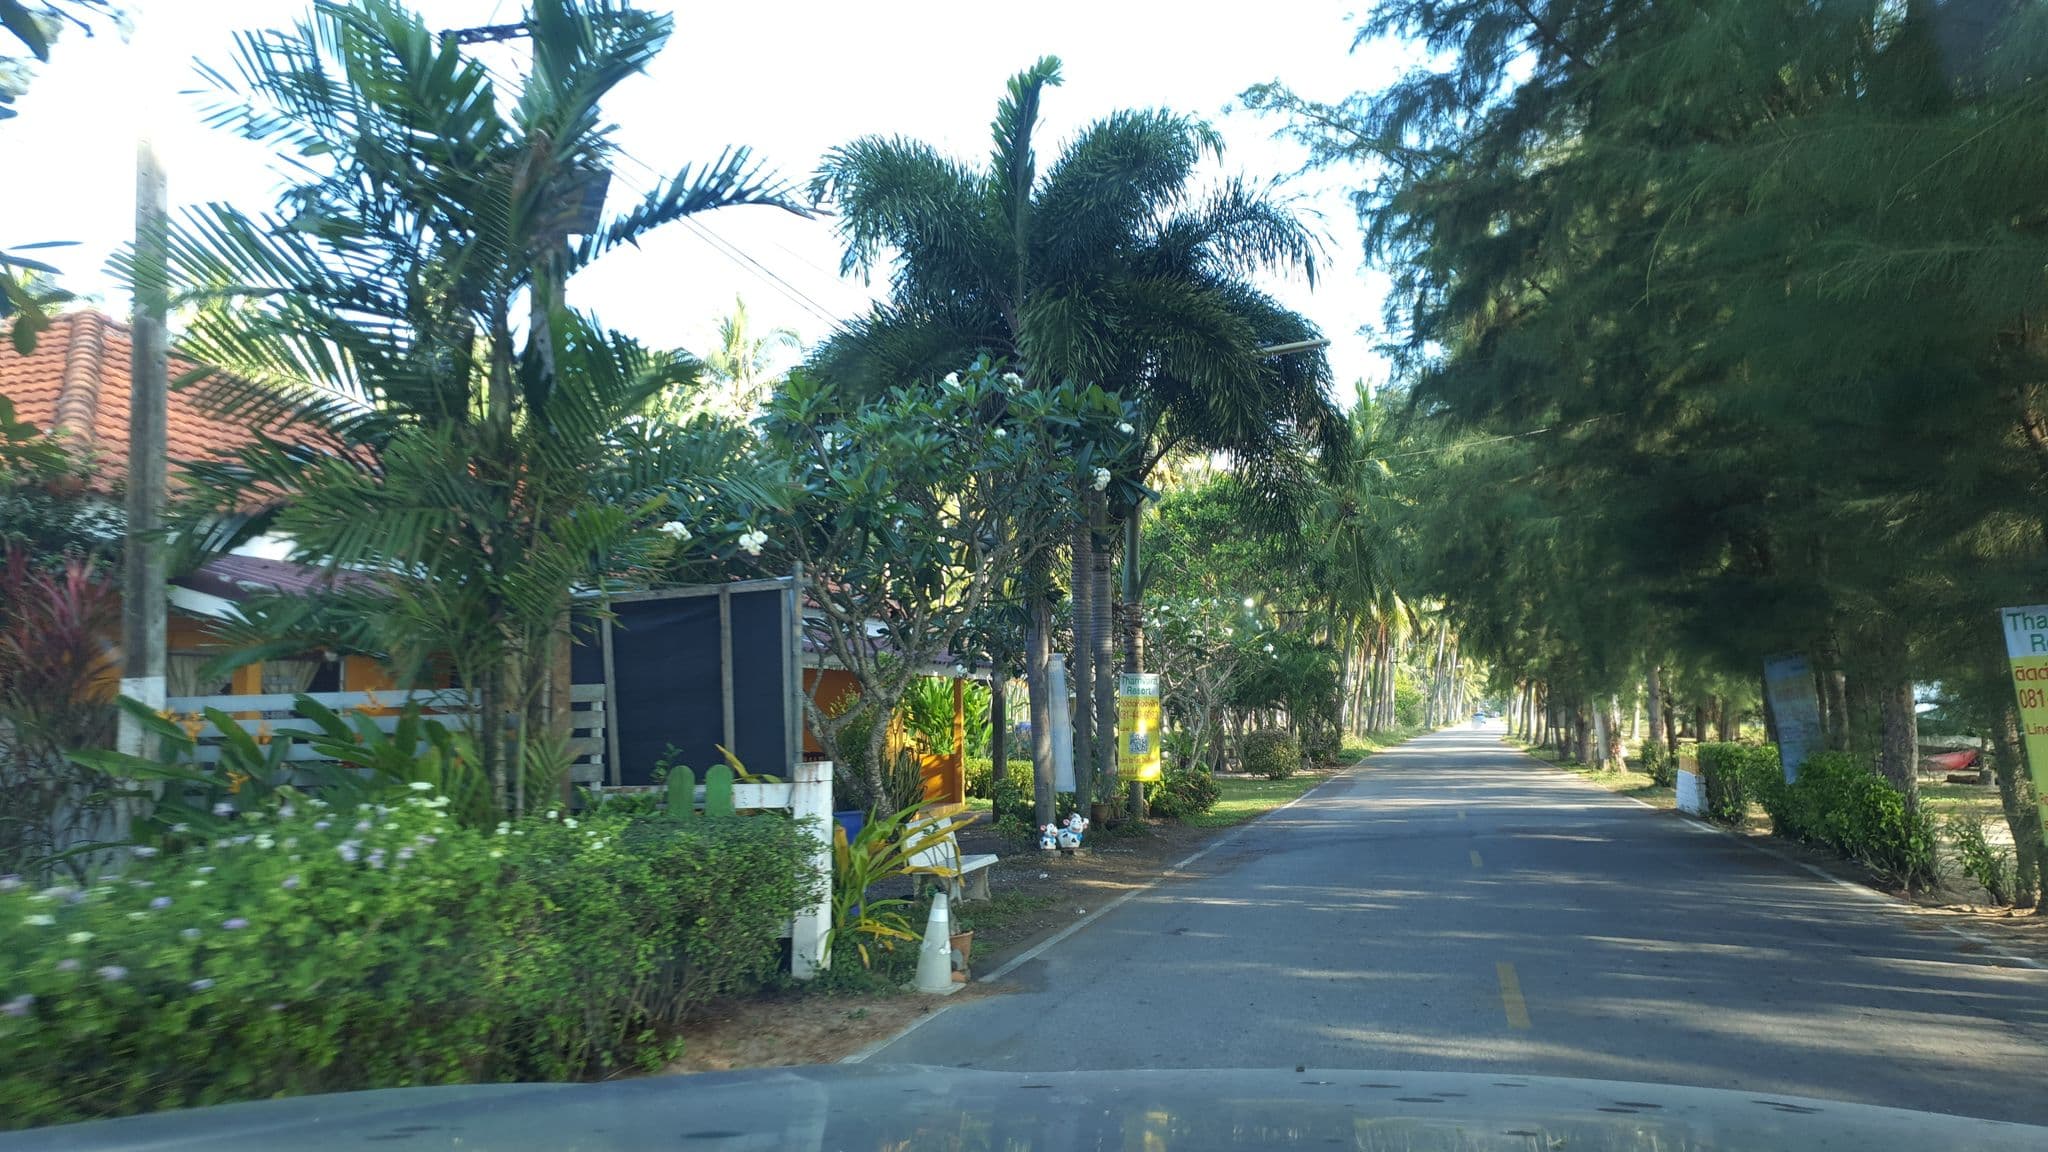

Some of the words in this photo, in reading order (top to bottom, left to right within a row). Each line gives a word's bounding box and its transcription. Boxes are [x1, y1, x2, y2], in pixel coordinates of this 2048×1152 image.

[2031, 633, 2048, 652] R
[1127, 686, 1152, 696] Resort
[2019, 688, 2048, 708] 081
